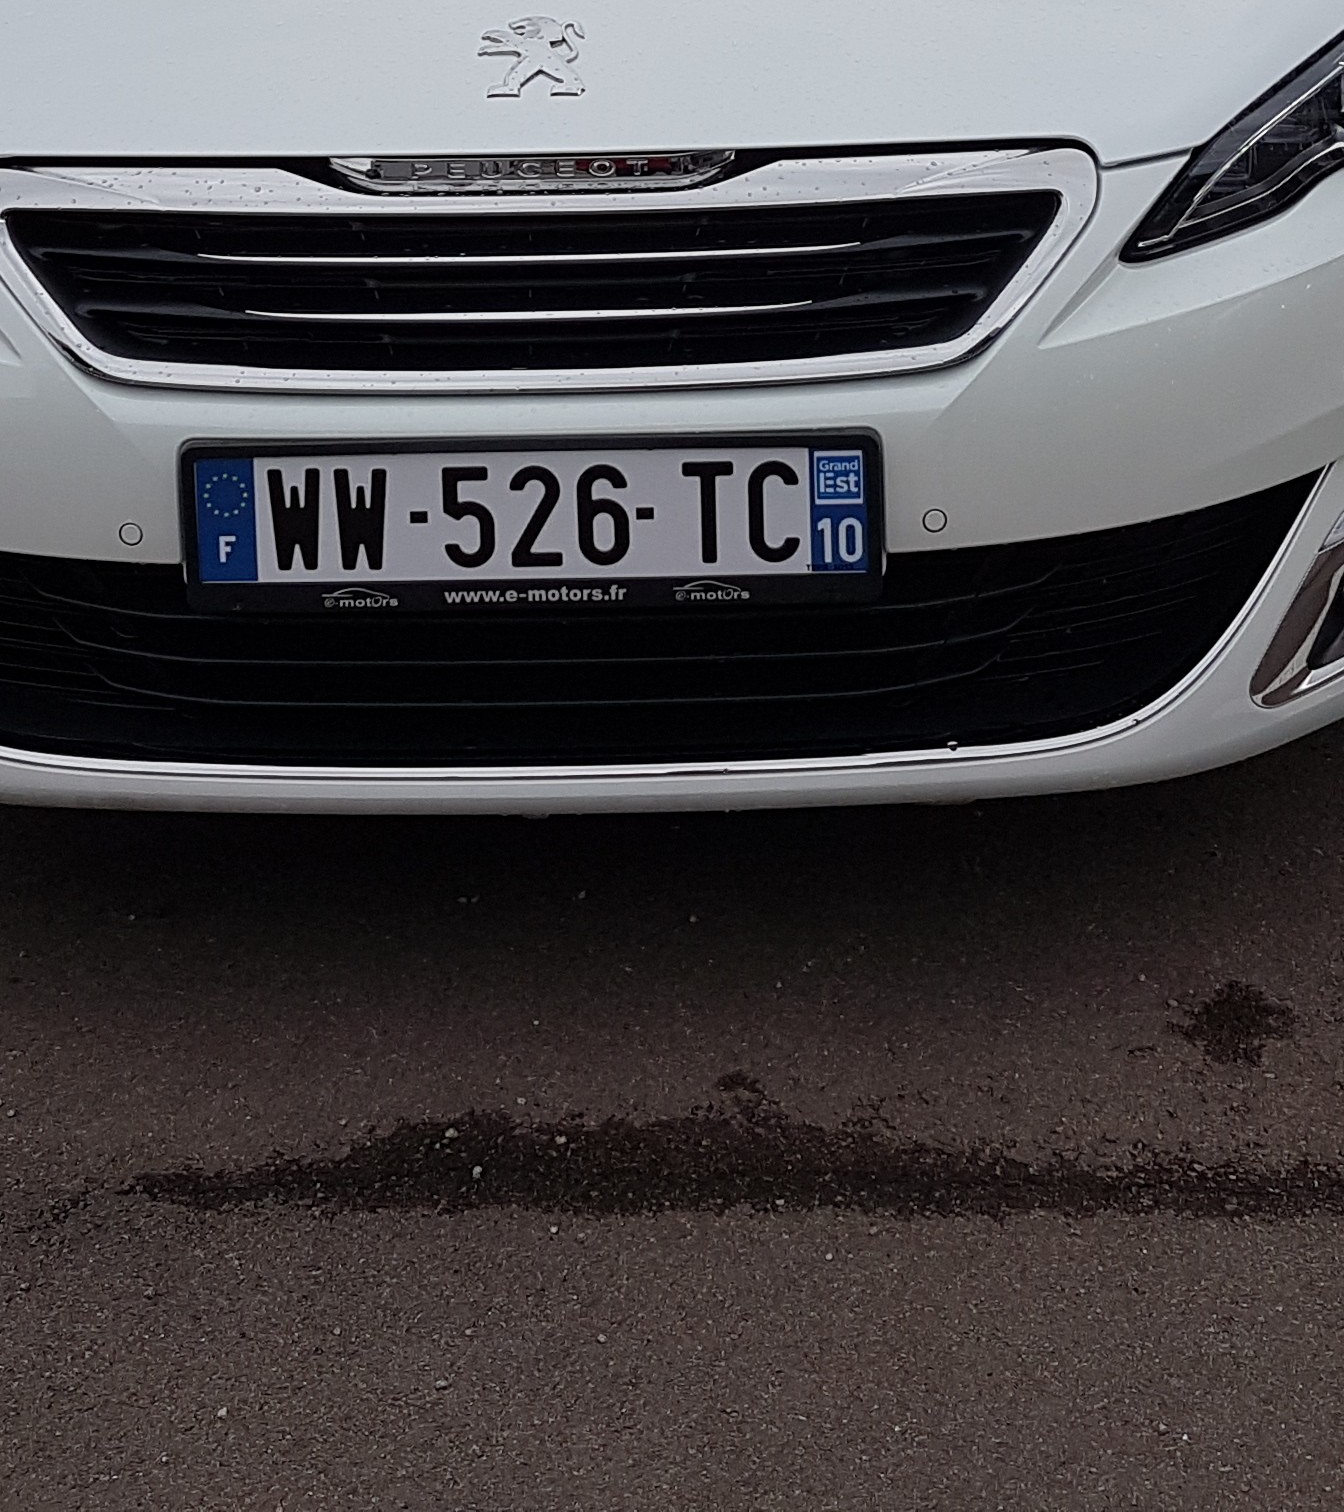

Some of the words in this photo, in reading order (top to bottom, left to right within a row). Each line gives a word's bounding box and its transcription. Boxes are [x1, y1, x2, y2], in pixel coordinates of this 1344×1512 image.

[411, 159, 649, 180] PEUGEOT
[818, 460, 859, 472] Grand
[819, 472, 859, 493] Est
[218, 535, 237, 564] F
[817, 517, 864, 564] 10
[444, 584, 627, 605] www.e-motors.fr
